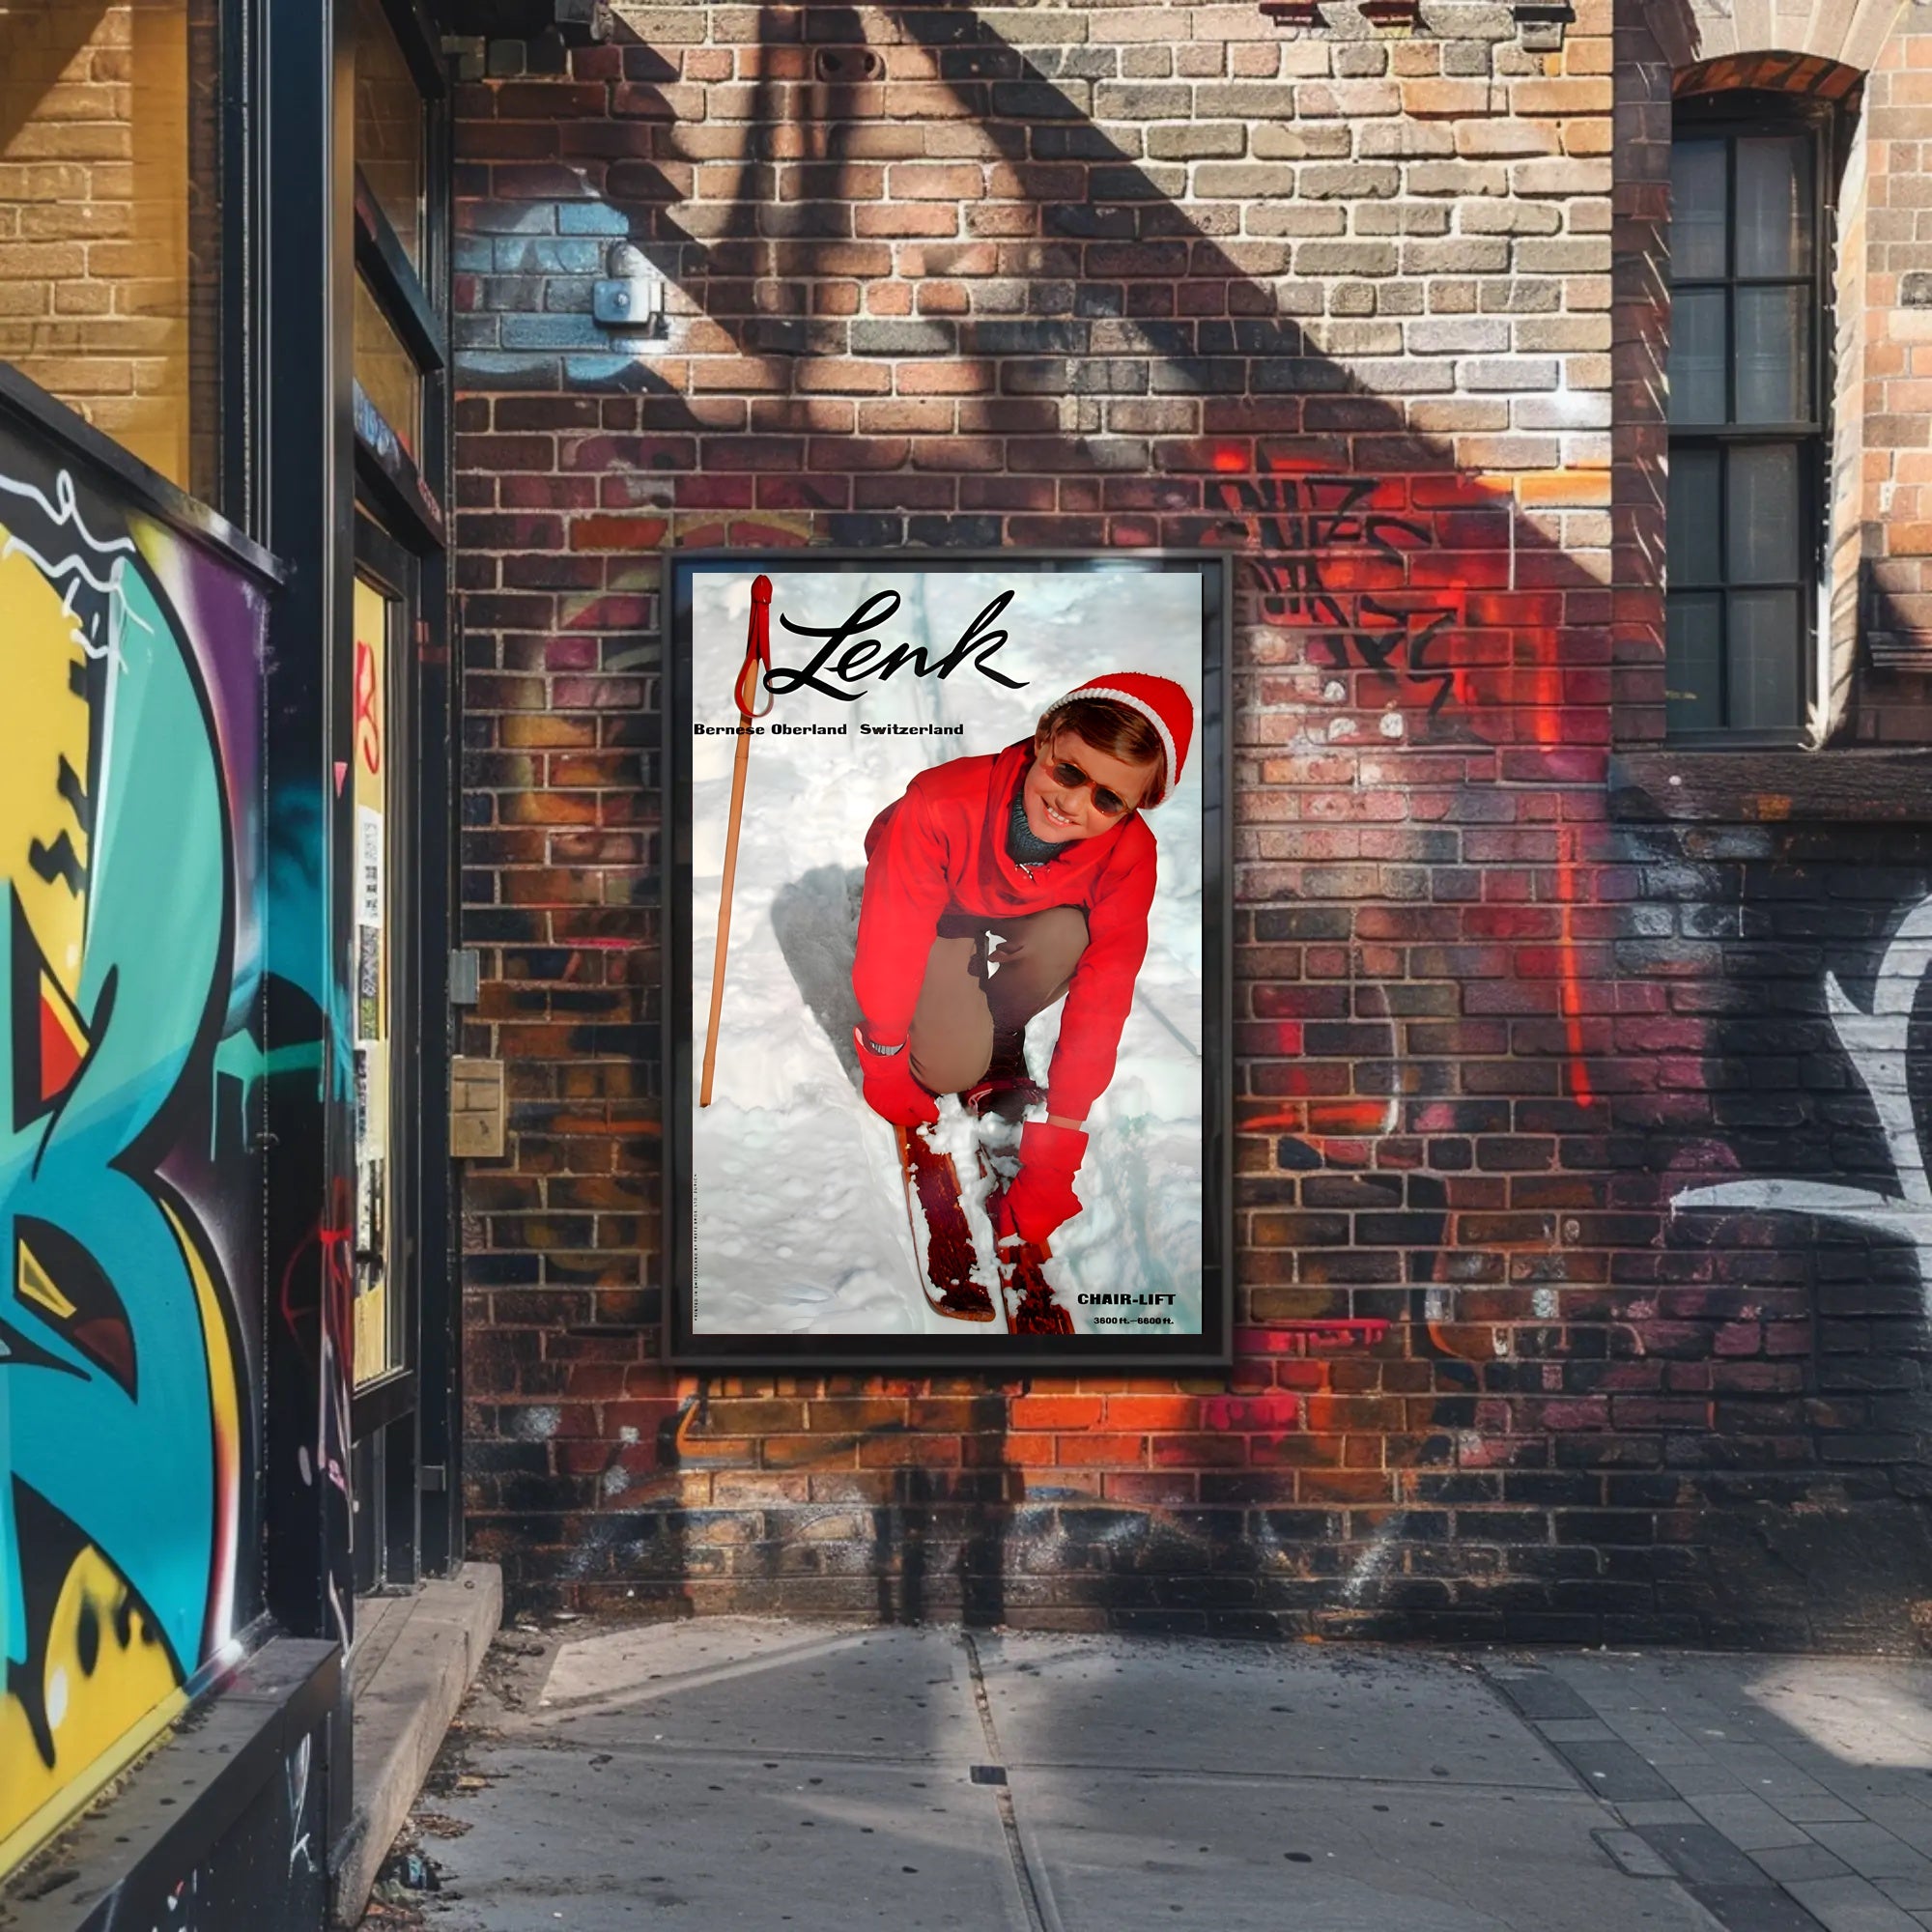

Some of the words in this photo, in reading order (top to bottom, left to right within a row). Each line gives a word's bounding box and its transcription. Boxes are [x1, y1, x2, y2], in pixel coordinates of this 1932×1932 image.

[762, 589, 1031, 702] Lenk
[694, 724, 765, 735] Bernese
[771, 724, 847, 735] Oberland
[860, 724, 964, 735] Switzerland
[1077, 1293, 1177, 1306] CHAIR-LIFT
